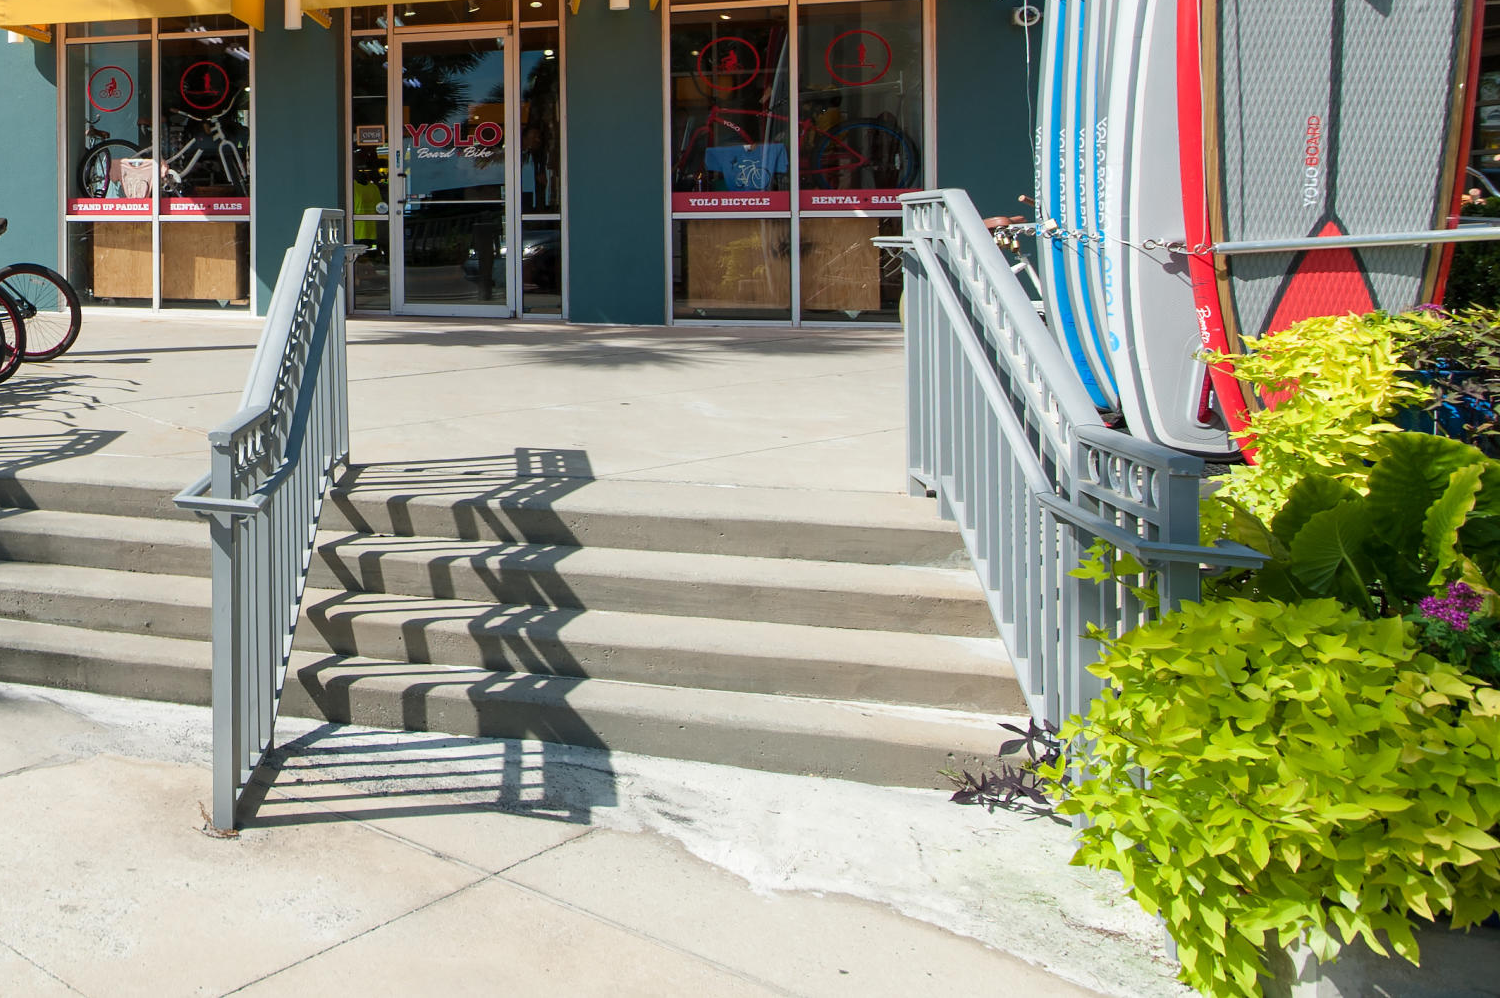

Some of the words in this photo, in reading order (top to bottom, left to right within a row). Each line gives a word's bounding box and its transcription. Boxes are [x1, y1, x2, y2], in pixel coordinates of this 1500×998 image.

[404, 121, 503, 148] YOLO
[416, 147, 457, 160] Board
[462, 145, 495, 159] Bike
[689, 198, 719, 207] YOLO
[721, 197, 771, 207] BICYCLE
[811, 196, 861, 205] RENTAL
[871, 195, 902, 204] SALE
[72, 203, 101, 211] STAND
[102, 203, 114, 211] UP
[115, 203, 150, 211] PADDLE
[170, 203, 206, 211] RENTAL
[213, 203, 243, 211] SALES
